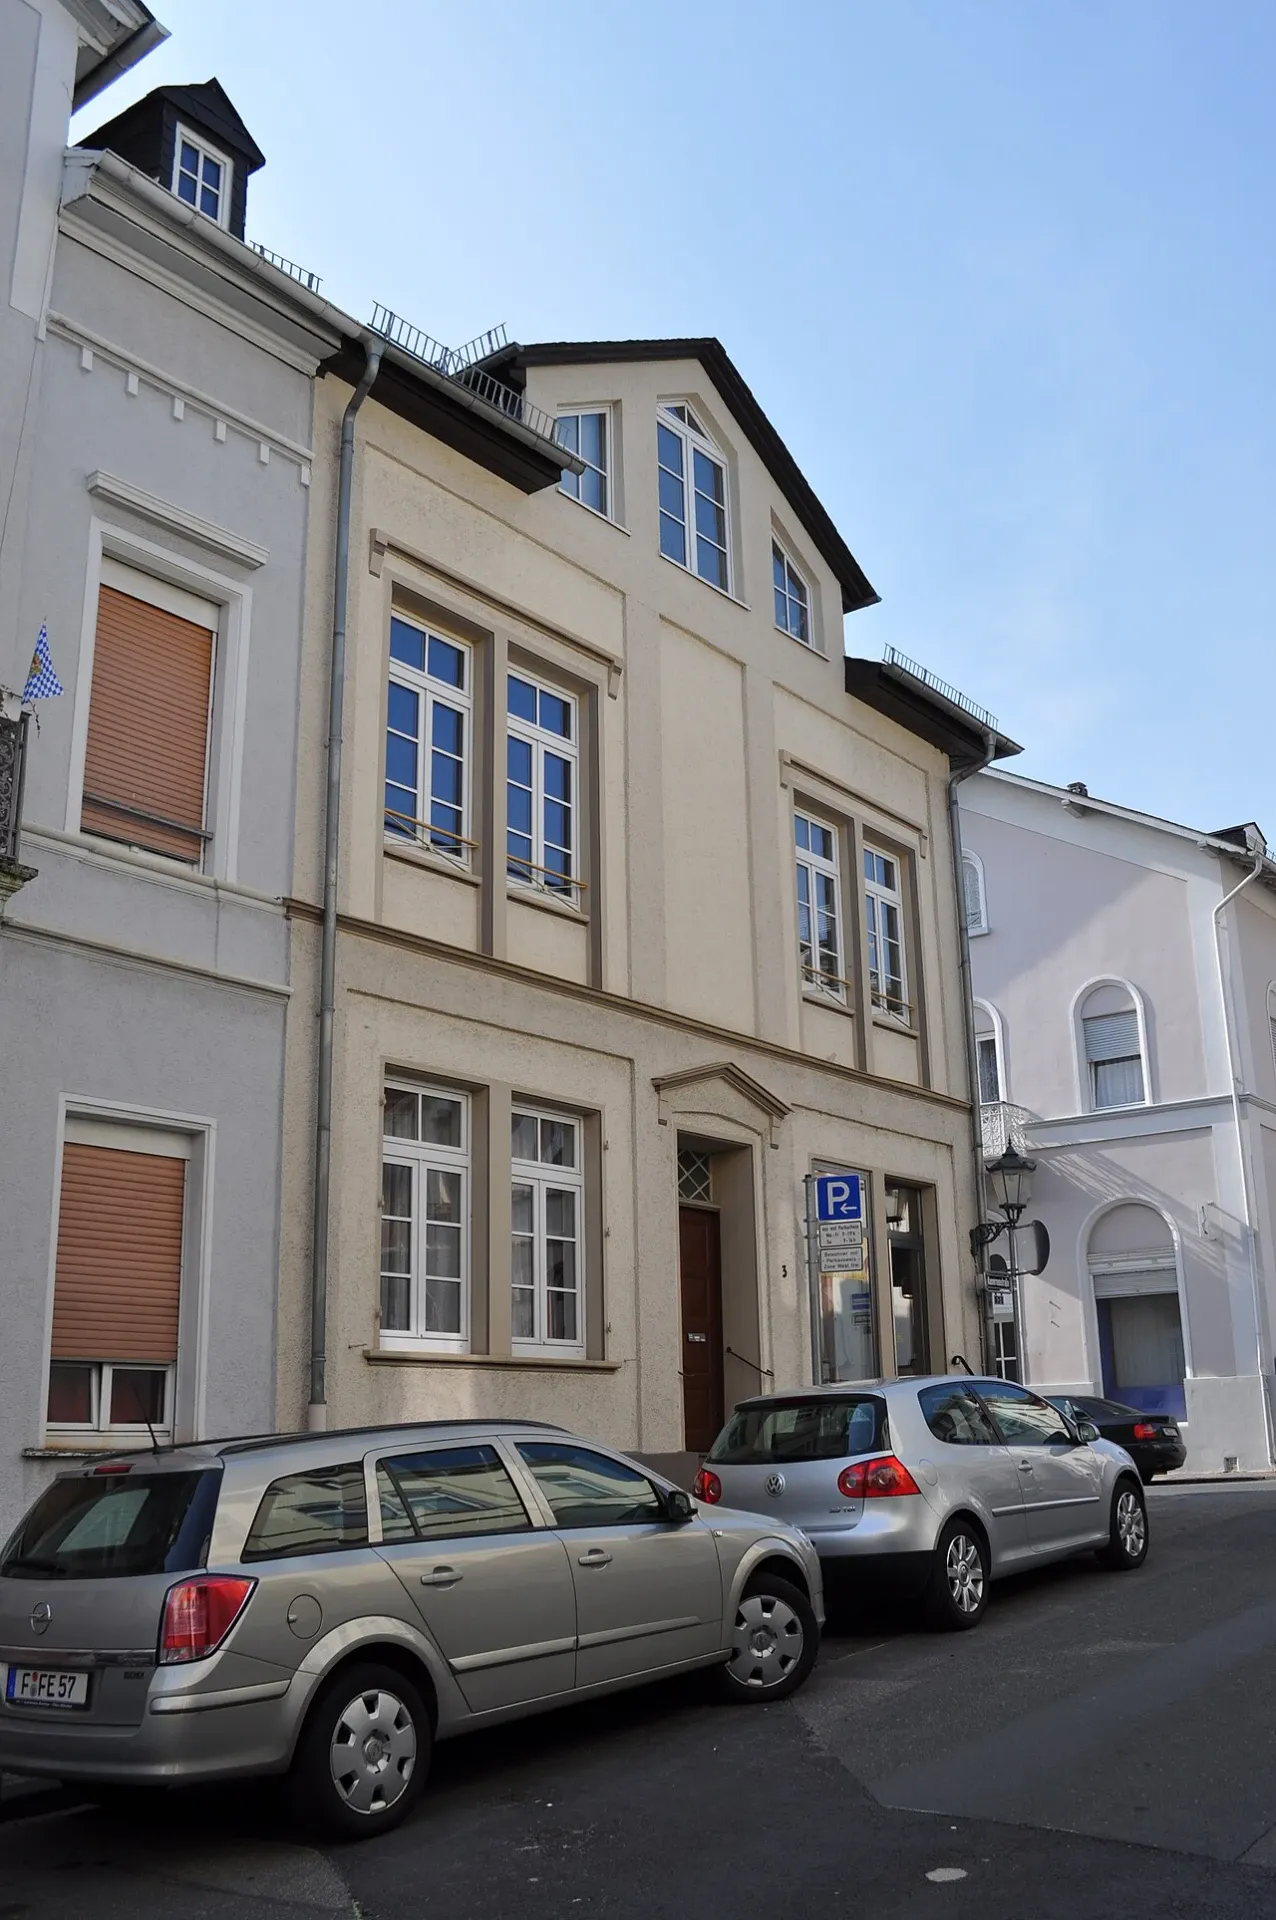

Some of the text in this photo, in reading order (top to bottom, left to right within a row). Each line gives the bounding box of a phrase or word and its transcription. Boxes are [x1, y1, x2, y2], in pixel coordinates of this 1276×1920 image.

[827, 1182, 850, 1215] P
[782, 1265, 787, 1278] 3
[21, 1673, 77, 1699] F FE 57
